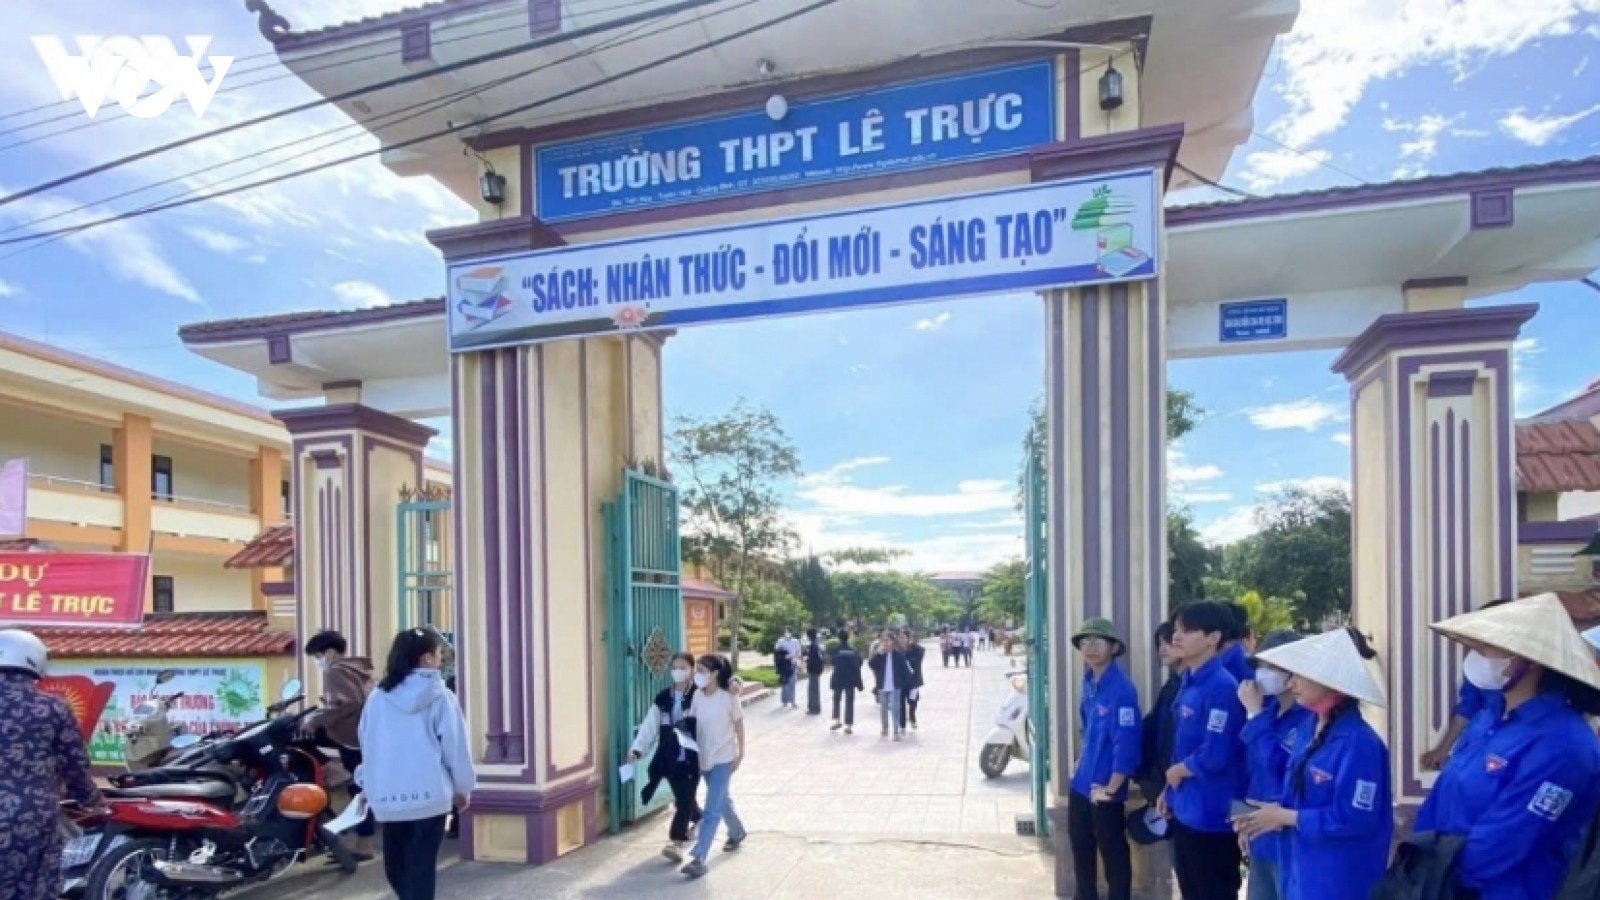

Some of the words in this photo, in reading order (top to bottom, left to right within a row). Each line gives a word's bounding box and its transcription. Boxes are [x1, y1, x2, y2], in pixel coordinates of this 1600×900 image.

[558, 146, 700, 198] TRƯỜNG
[719, 125, 818, 173] THPT
[838, 108, 885, 156] LÊ
[904, 92, 1023, 145] TRỰC
[521, 265, 599, 313] “SÁCH:
[606, 253, 672, 307] NHẬN
[679, 244, 746, 295] THỨC
[754, 265, 765, 274] -
[772, 225, 819, 285] ĐỔI
[828, 225, 881, 280] MỚI
[890, 248, 900, 258] -
[908, 216, 986, 270] SÁNG
[995, 207, 1067, 266] TẠO”
[12, 590, 41, 613] LÊ
[50, 594, 115, 618] TRỰC
